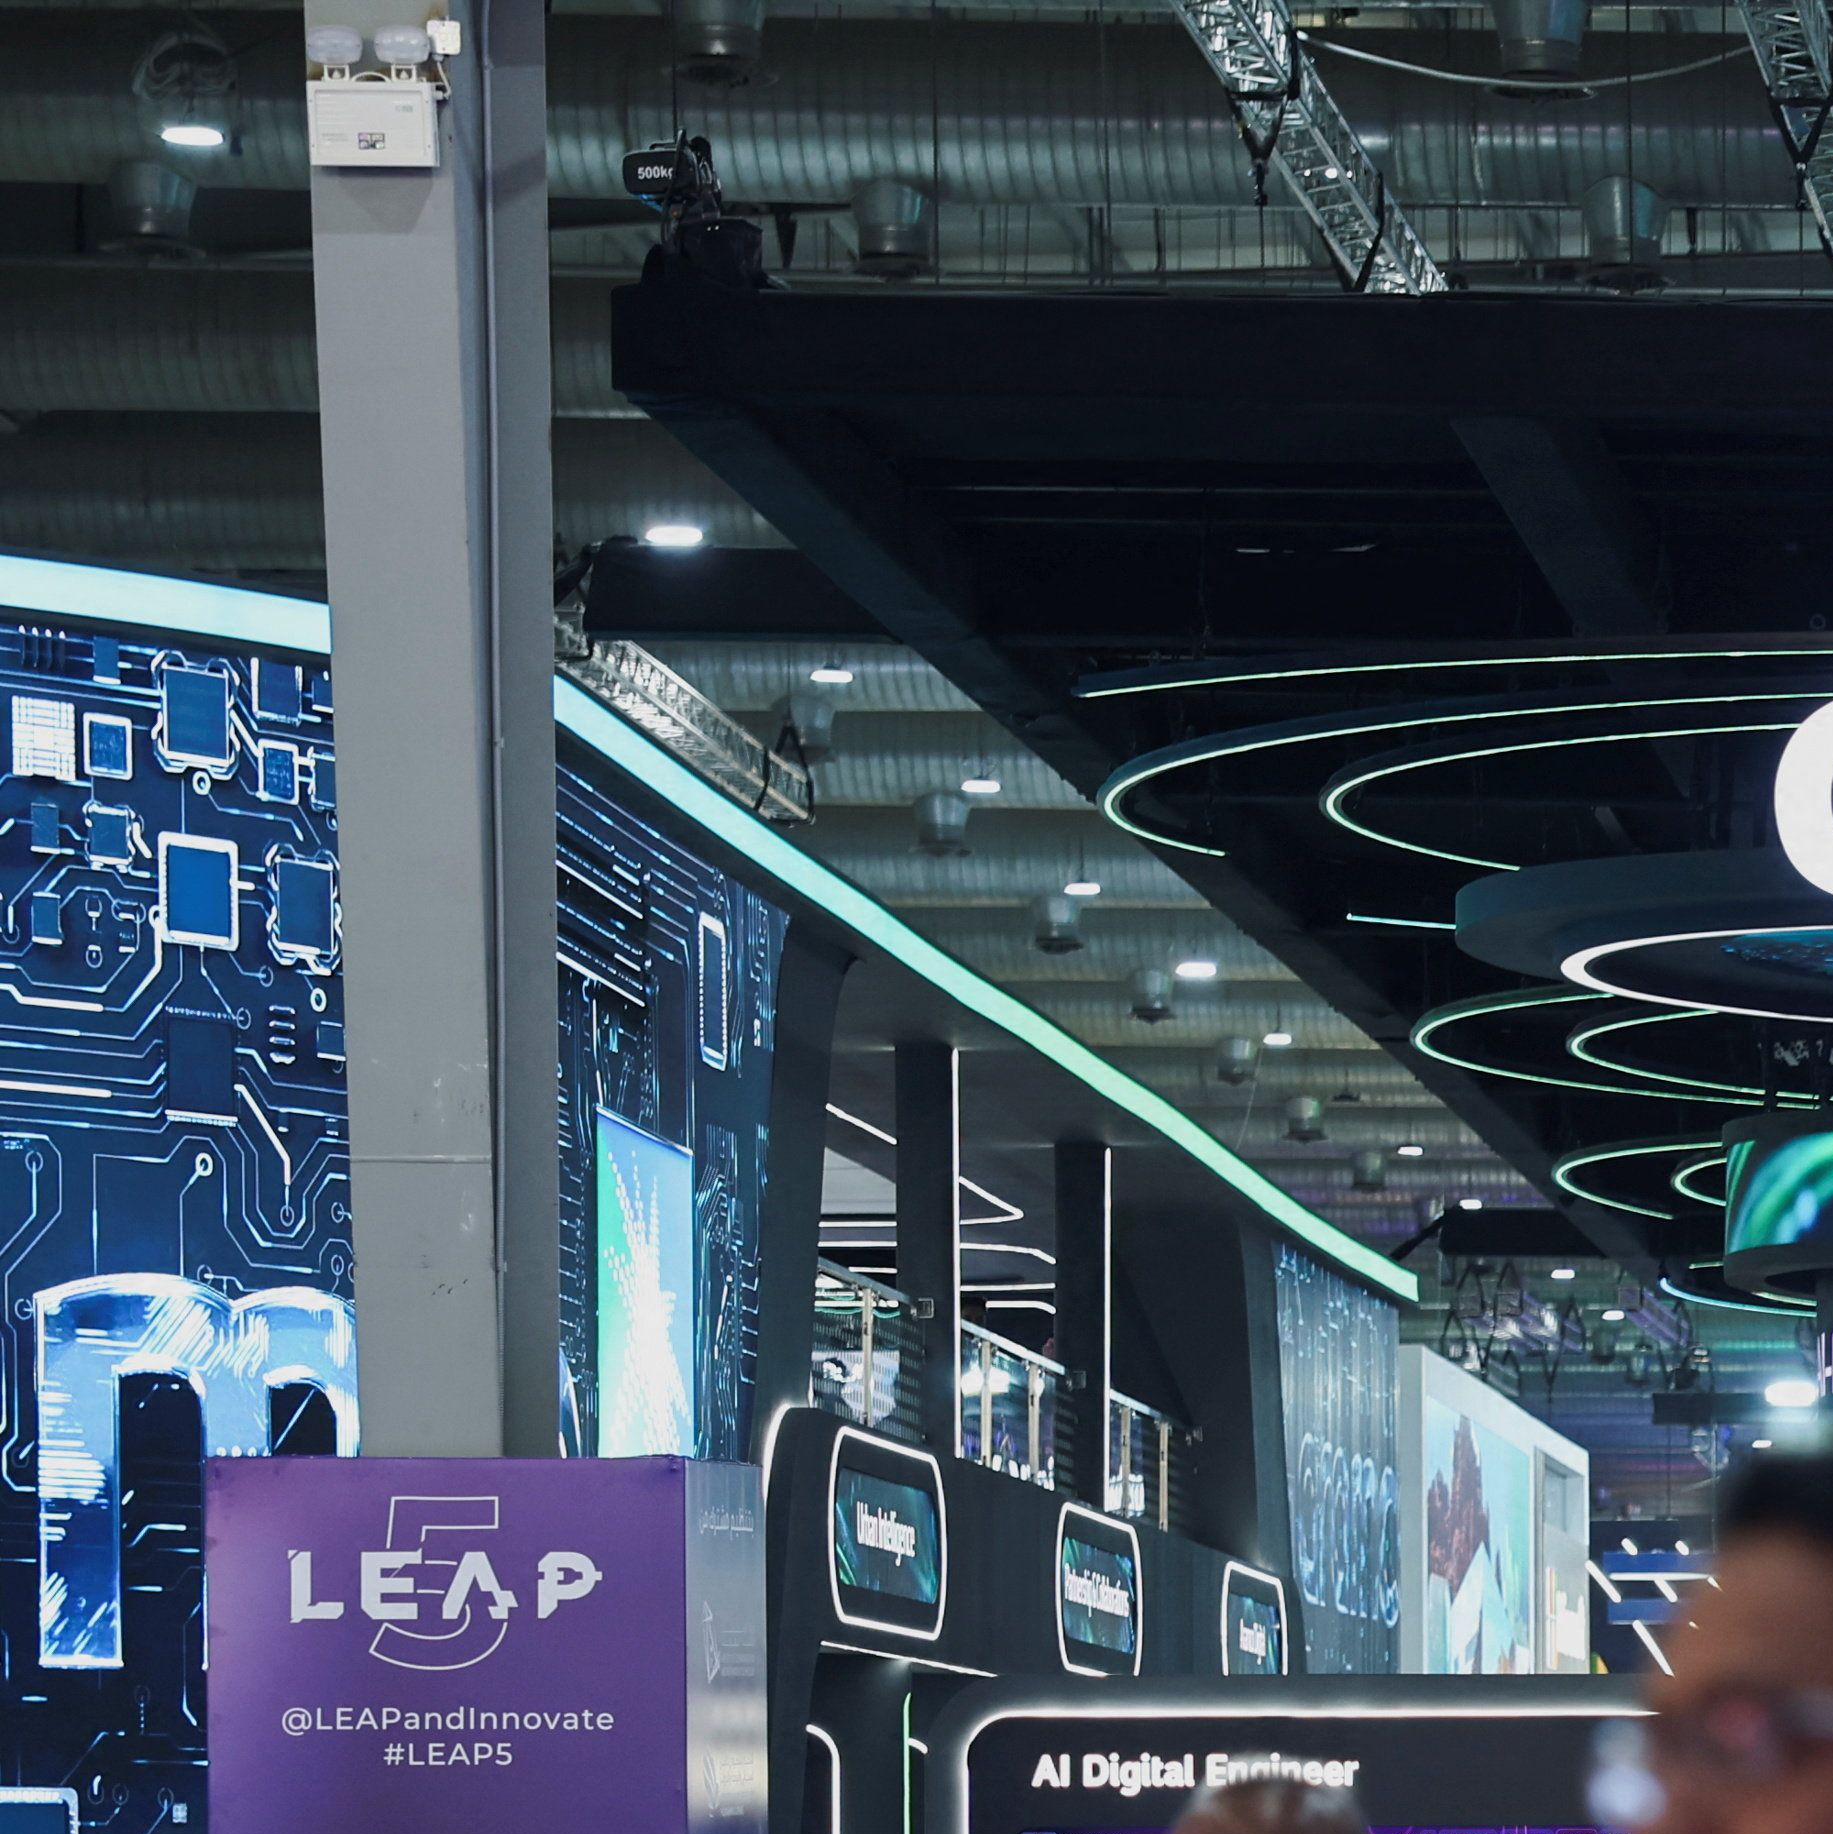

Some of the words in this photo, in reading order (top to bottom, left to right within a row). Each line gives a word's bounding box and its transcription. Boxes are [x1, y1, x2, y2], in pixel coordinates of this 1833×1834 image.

[287, 1549, 603, 1623] LEAP
[281, 1706, 615, 1736] @LEAPandInnovate
[383, 1742, 513, 1766] #LEAP5
[1031, 1754, 1071, 1788] AI
[1082, 1752, 1195, 1797] Digital
